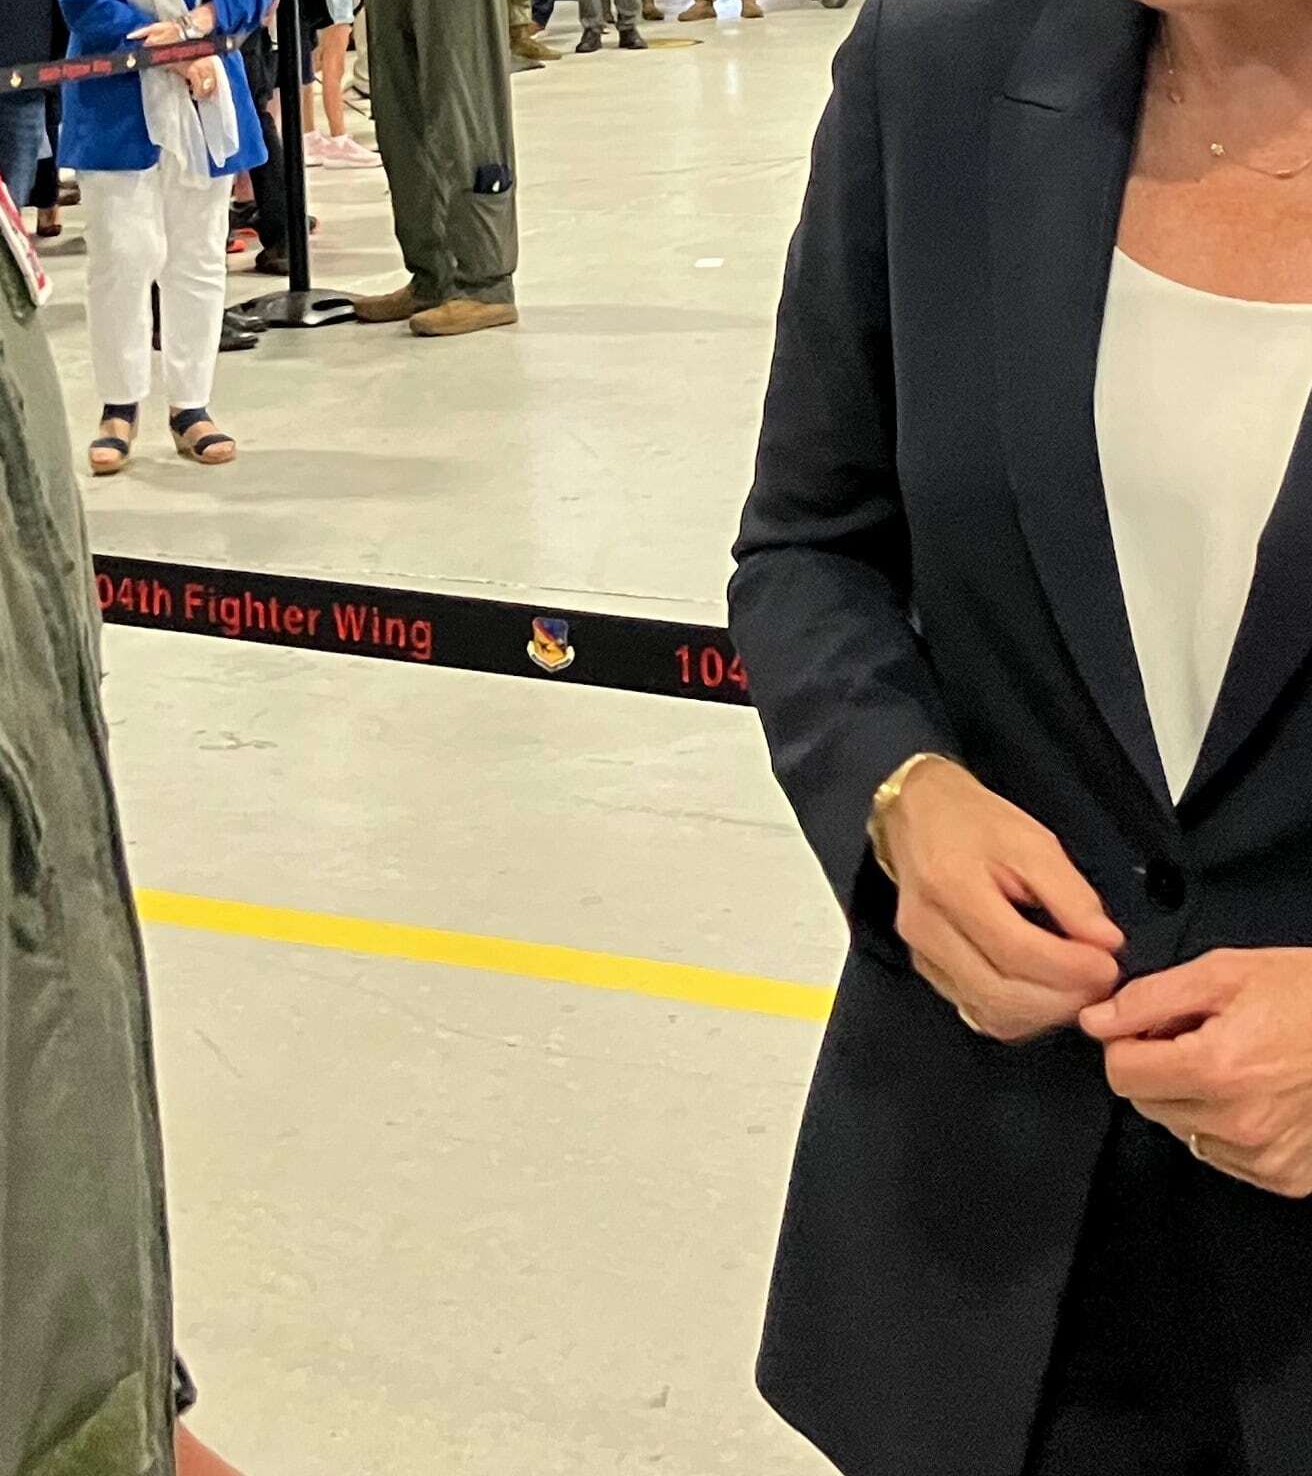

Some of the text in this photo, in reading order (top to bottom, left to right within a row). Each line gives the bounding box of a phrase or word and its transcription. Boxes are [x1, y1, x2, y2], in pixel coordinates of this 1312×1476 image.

[95, 573, 432, 661] 04th Fighter Wing
[674, 644, 751, 692] 104
